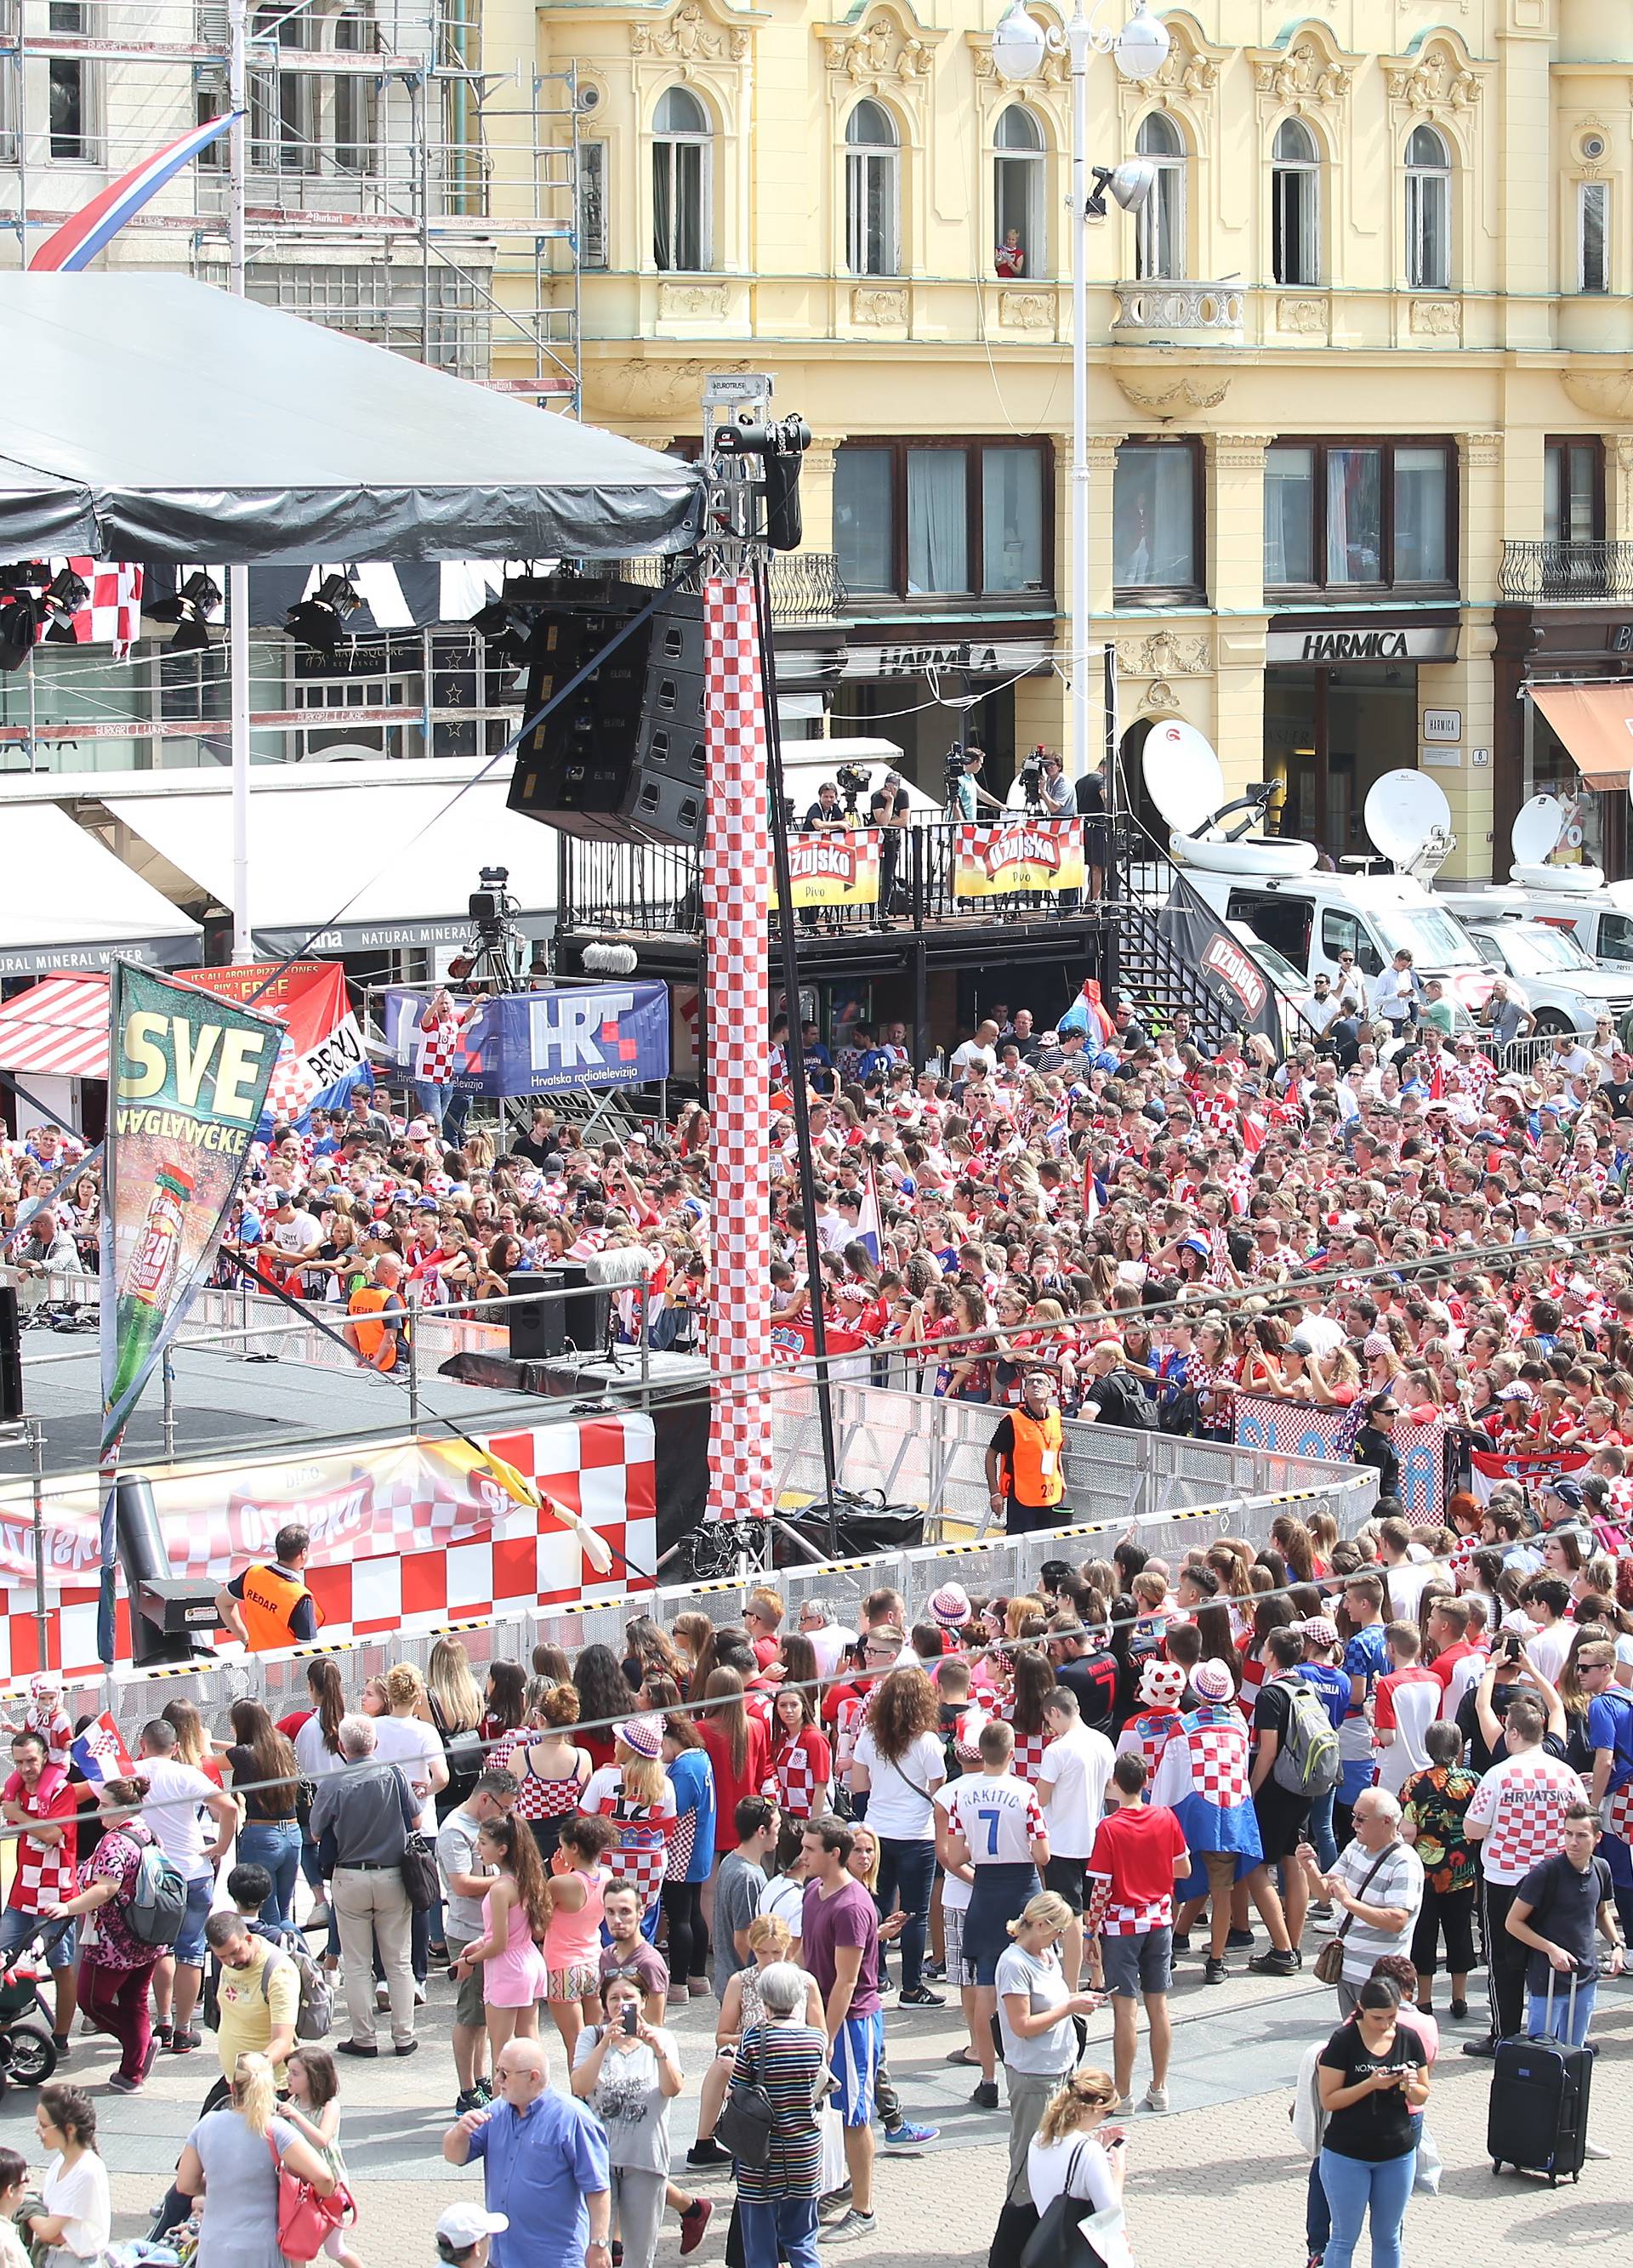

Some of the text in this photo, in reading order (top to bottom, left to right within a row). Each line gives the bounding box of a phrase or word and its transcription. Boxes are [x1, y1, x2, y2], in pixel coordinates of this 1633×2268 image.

[313, 213, 343, 224] Burkart
[1302, 632, 1408, 659] HARMICA
[1430, 719, 1454, 731] HARMICA
[1477, 751, 1482, 761] 6
[361, 927, 416, 946] NATURAL
[420, 924, 472, 941] MINERAL
[36, 952, 95, 969] MINERAL
[100, 949, 143, 963] WTER
[225, 968, 254, 979] ABOUT
[241, 979, 289, 1000] FREE
[529, 992, 634, 1071] HRT
[117, 1011, 265, 1119] SVE
[531, 1066, 638, 1088] Hrvatska radiotelevizija
[245, 1588, 278, 1614] REDAR
[1095, 1671, 1117, 1713] 7
[1504, 1789, 1573, 1804] HRVATSKA
[978, 1809, 1002, 1856] 7
